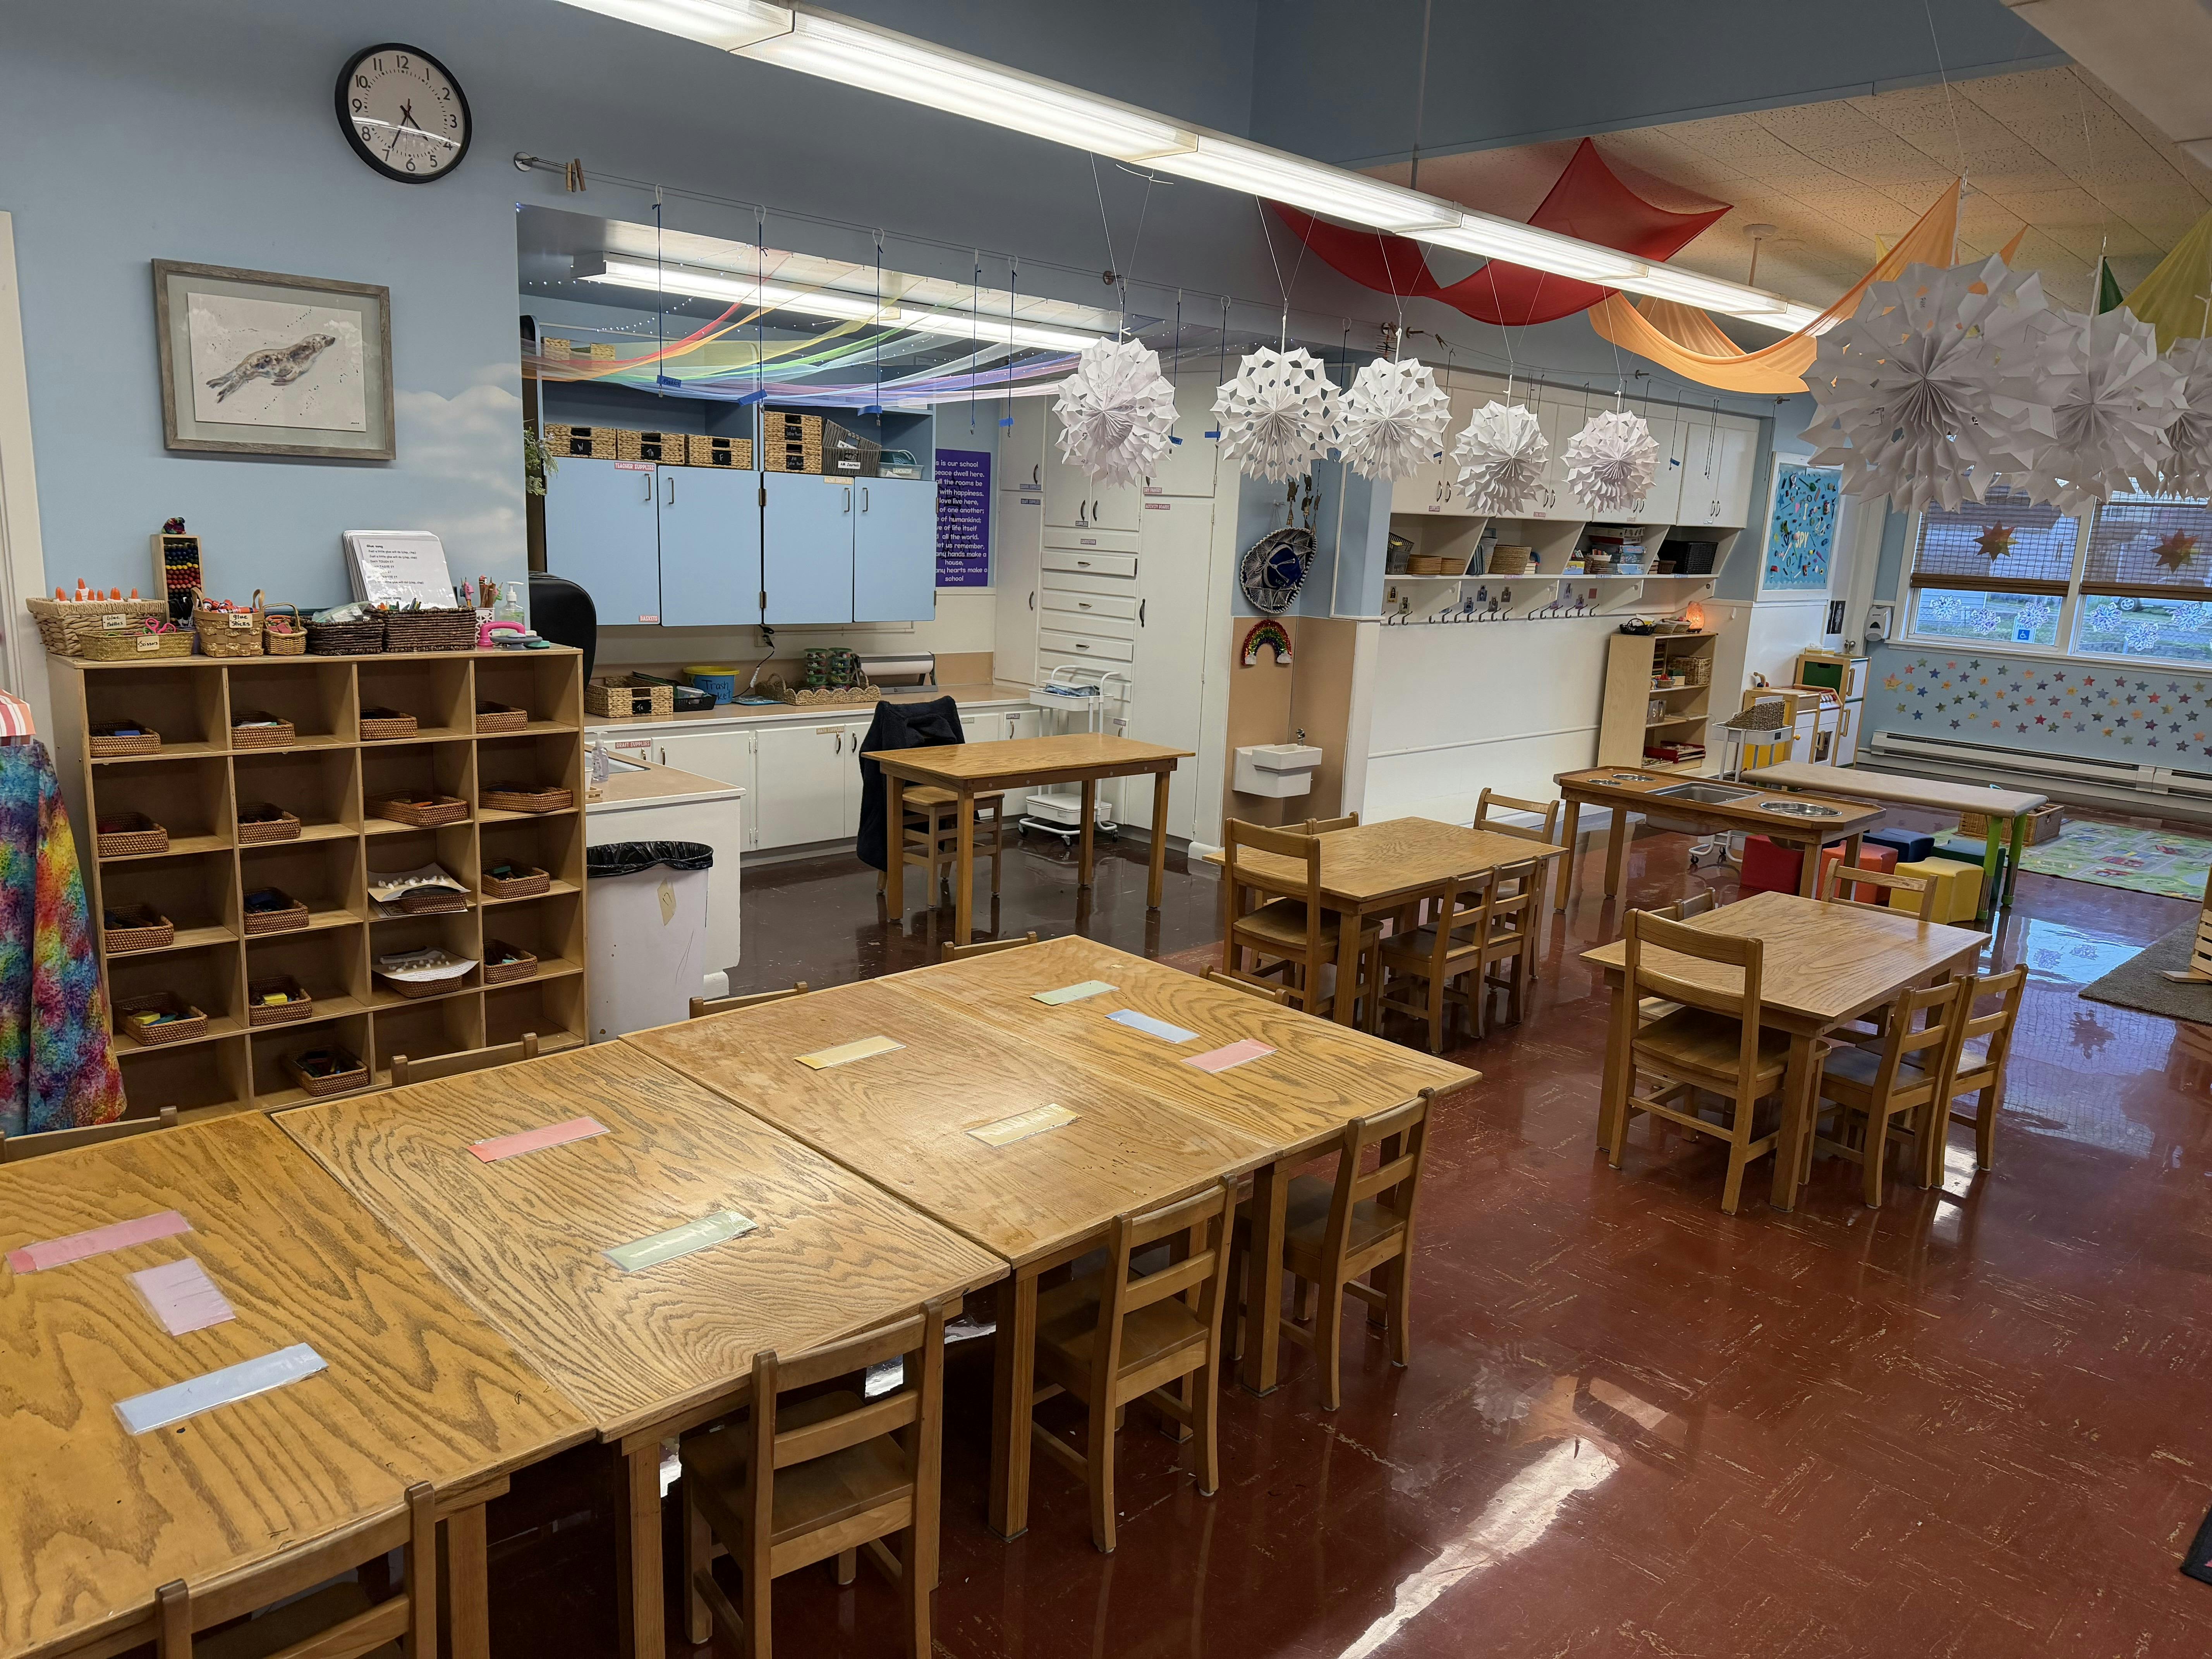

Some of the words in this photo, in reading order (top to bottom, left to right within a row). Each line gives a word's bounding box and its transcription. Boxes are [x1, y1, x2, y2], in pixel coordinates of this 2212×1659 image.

[373, 57, 383, 71] 11
[396, 55, 409, 69] 12
[356, 74, 368, 88] 10
[425, 68, 430, 80] 1
[442, 88, 450, 100] 2
[352, 98, 362, 113] 9
[450, 114, 457, 129] 3
[362, 126, 371, 141] 8
[443, 137, 453, 151] 4
[382, 149, 390, 162] 7
[430, 155, 438, 168] 5
[406, 158, 416, 172] 6
[647, 448, 654, 457] Th
[702, 680, 728, 690] Trash
